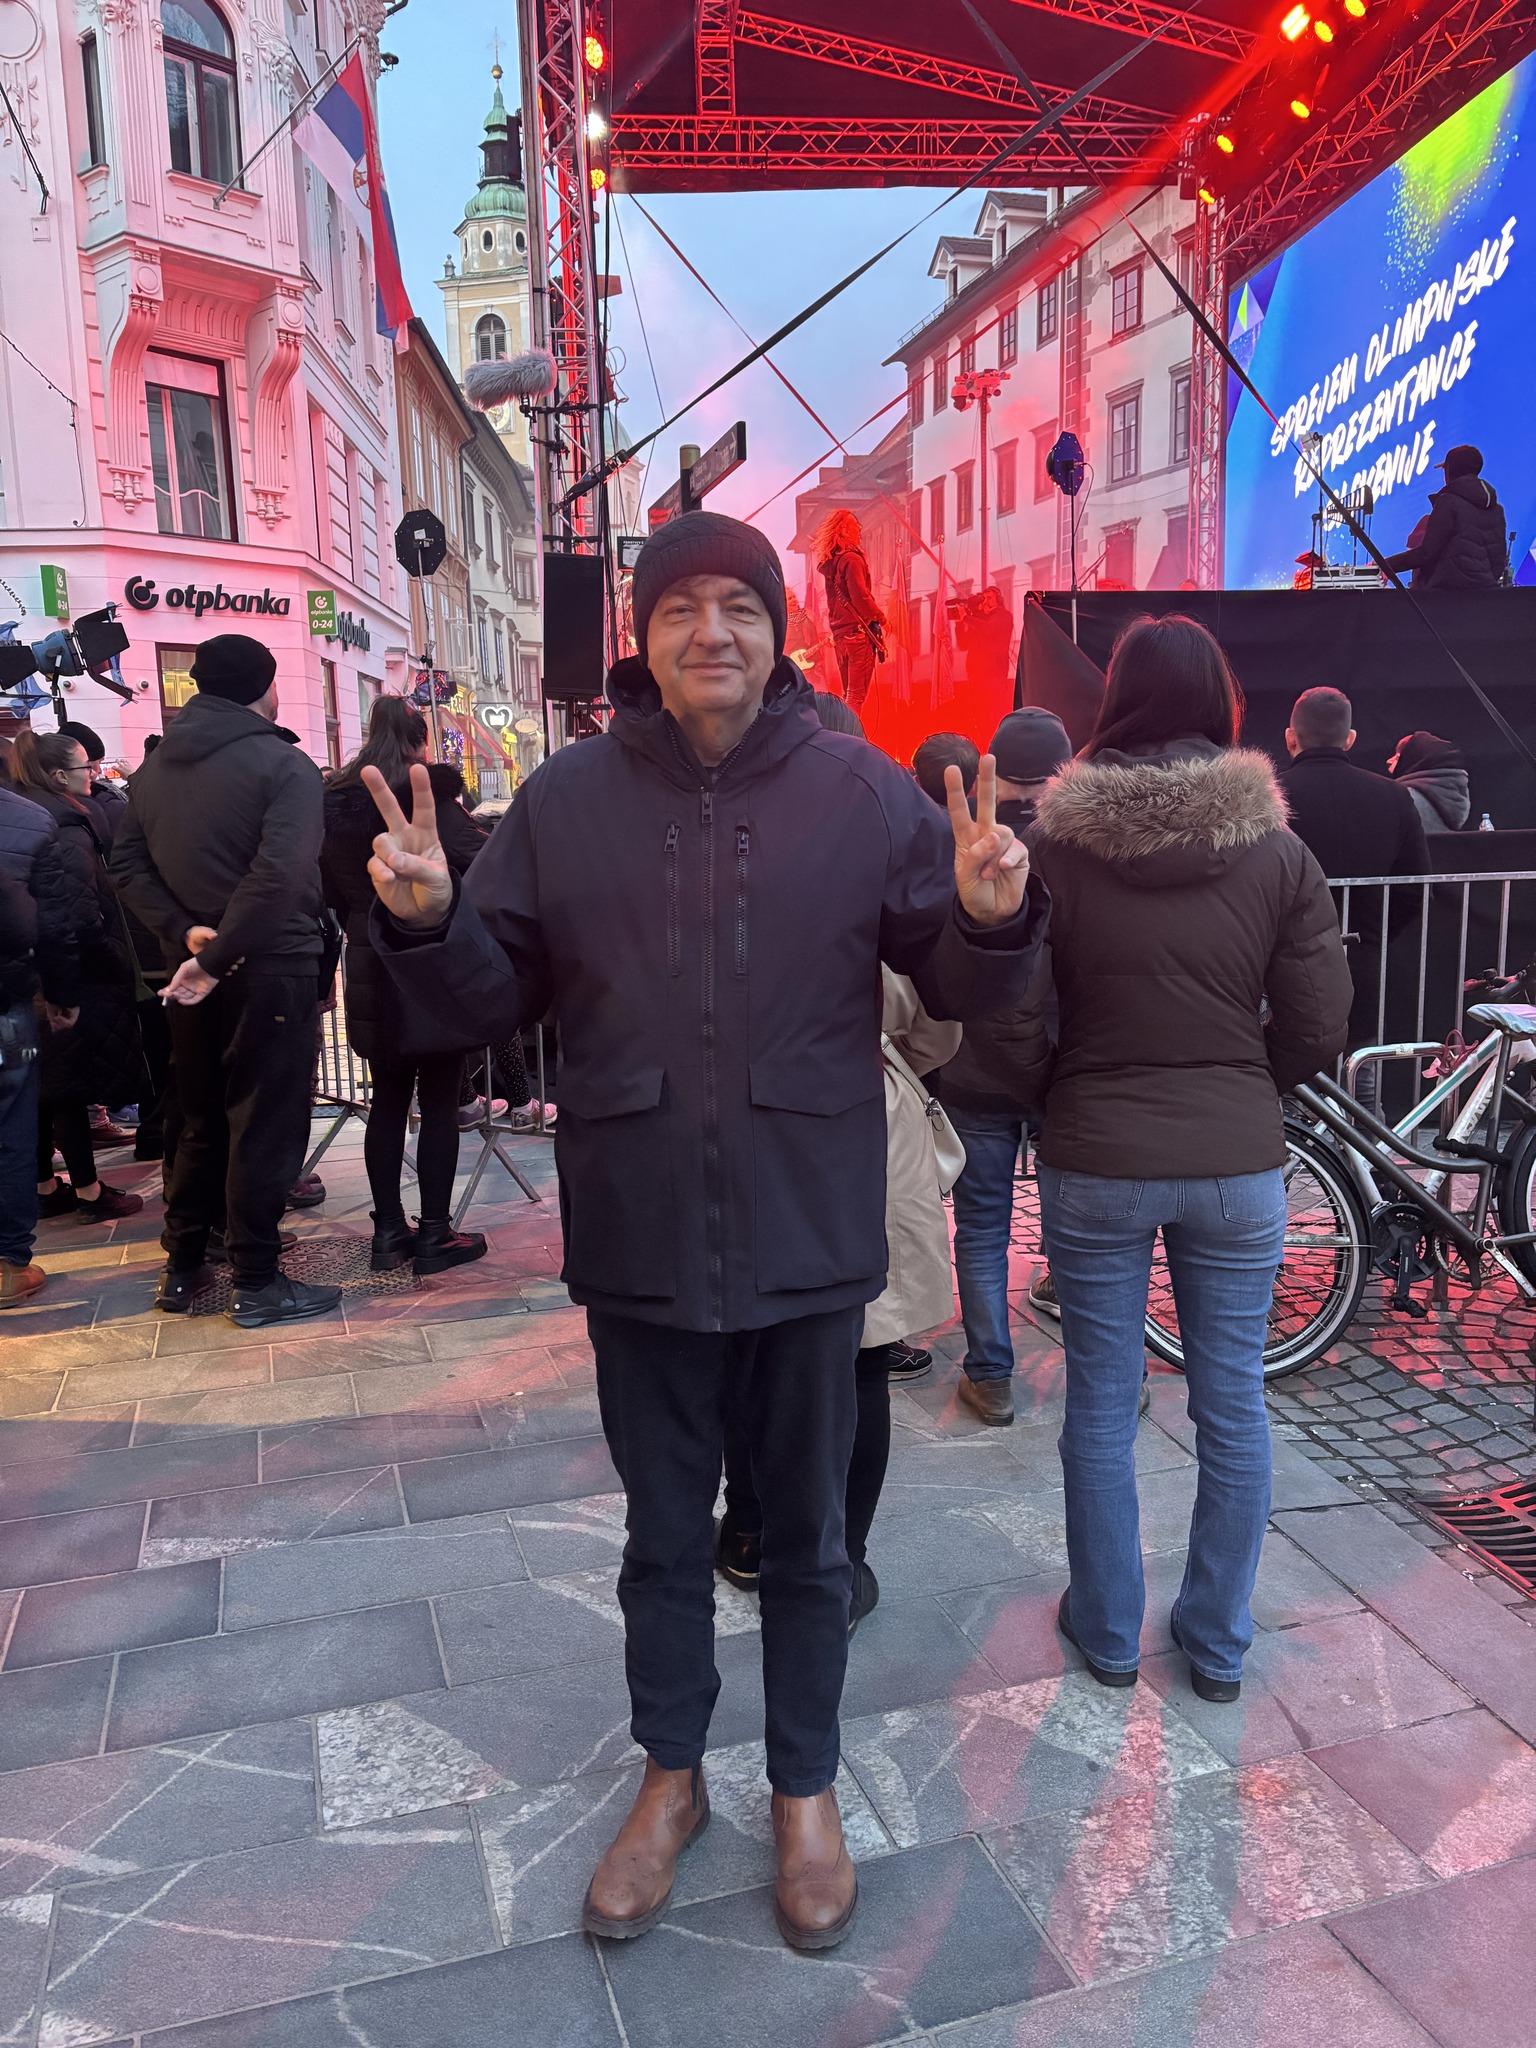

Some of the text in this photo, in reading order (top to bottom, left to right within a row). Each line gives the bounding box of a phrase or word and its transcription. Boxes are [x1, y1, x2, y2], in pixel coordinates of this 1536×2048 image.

[1271, 216, 1517, 457] SPREJEM OLIMPIJSKE
[166, 584, 291, 617] otpbanka
[312, 619, 333, 629] 0-24
